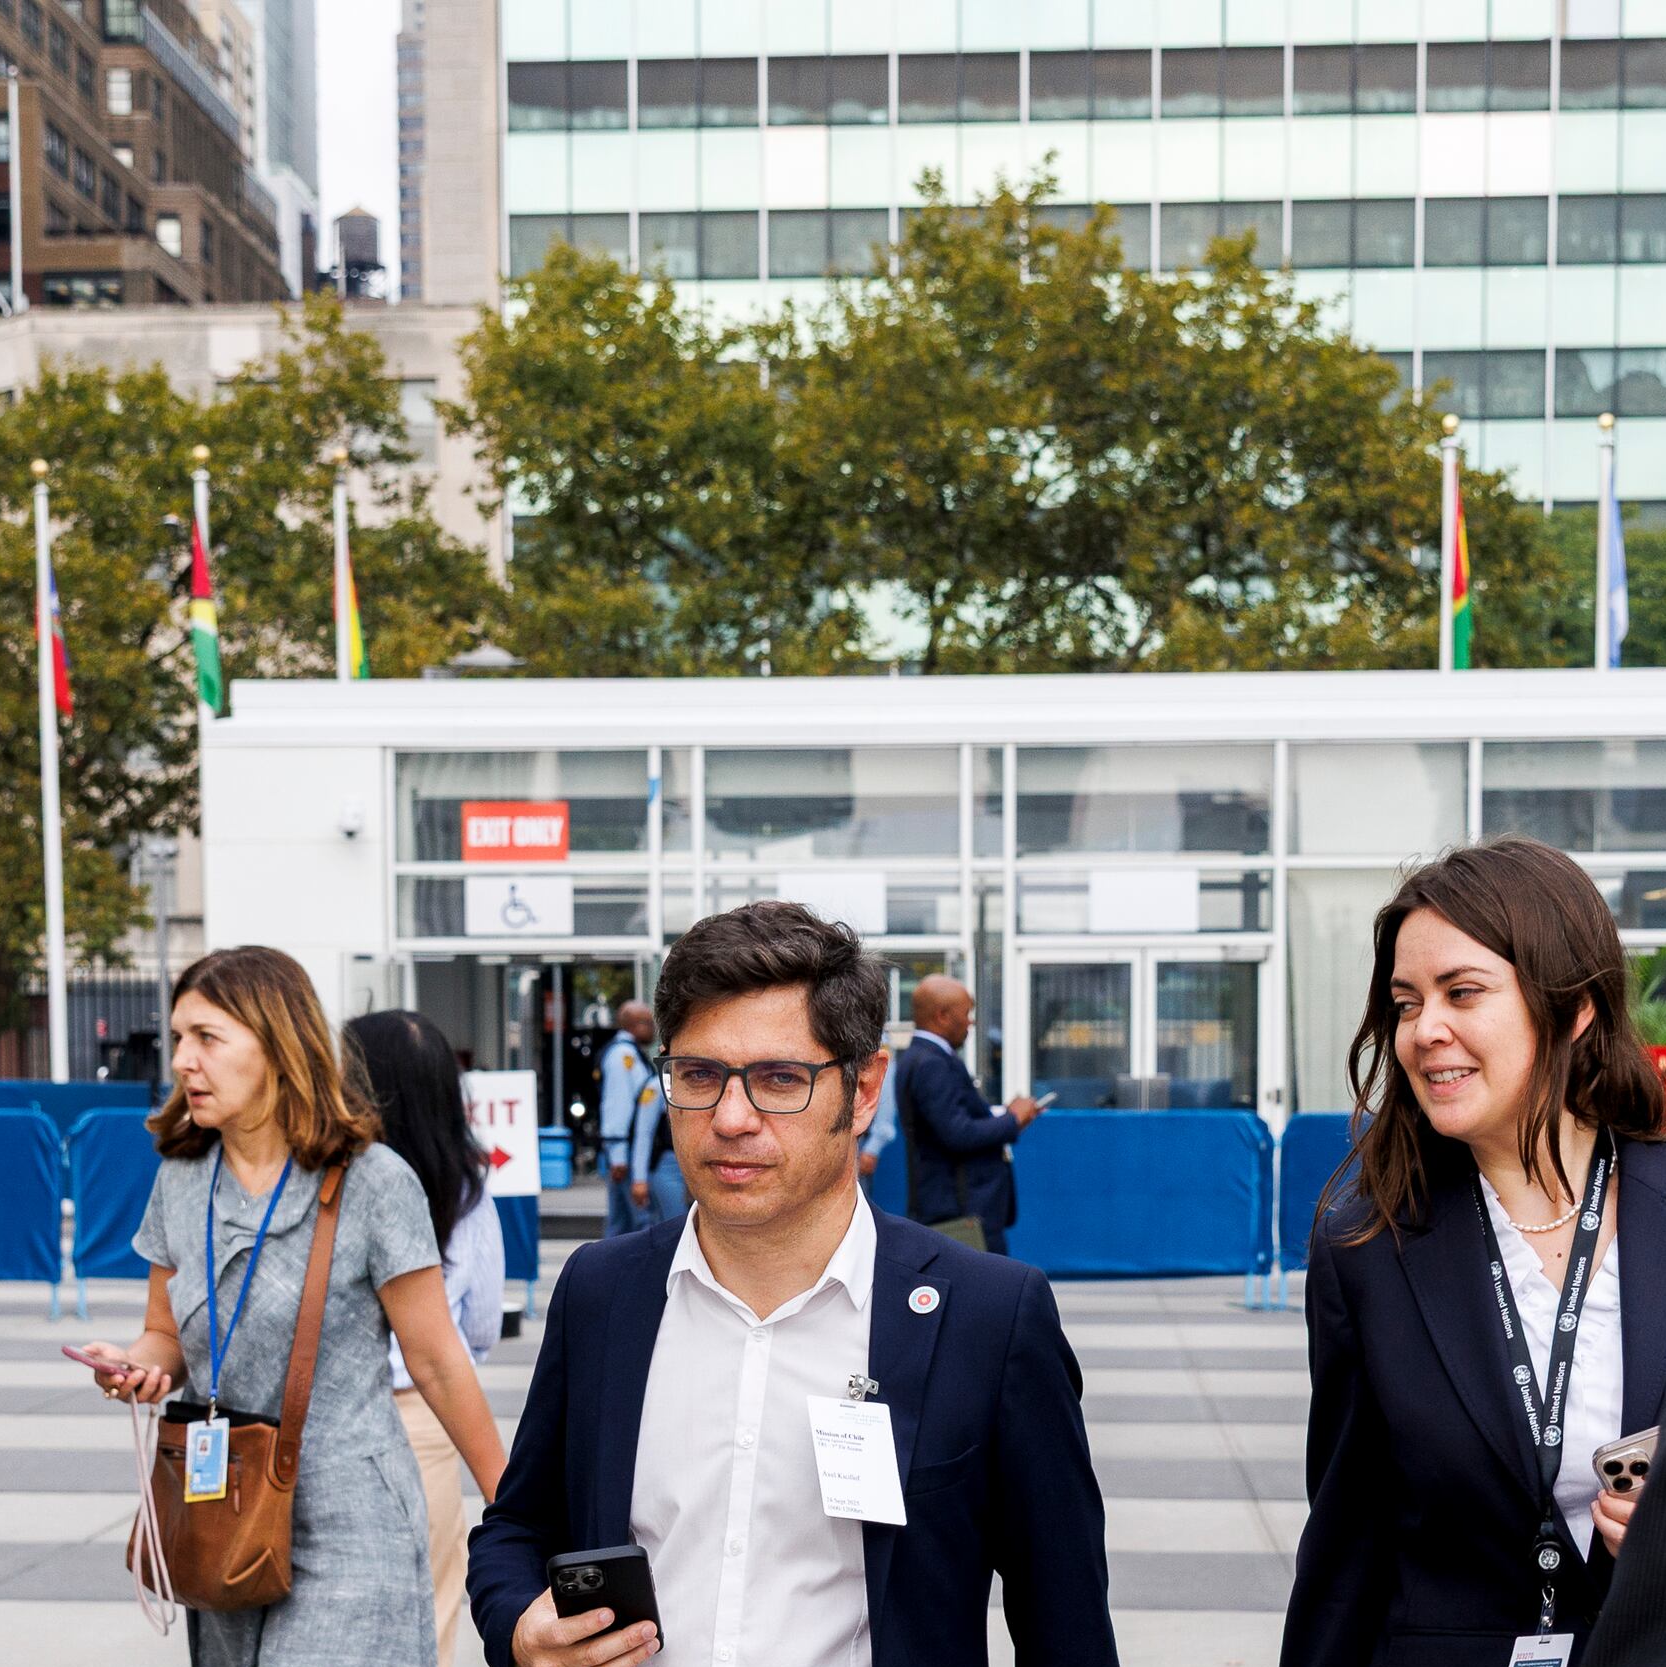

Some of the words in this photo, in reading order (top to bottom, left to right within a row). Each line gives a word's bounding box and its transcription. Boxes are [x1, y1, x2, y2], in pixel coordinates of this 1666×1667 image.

[467, 815, 510, 847] EXIT
[513, 815, 564, 847] ONLY
[465, 1099, 520, 1125] XIT
[1594, 1158, 1606, 1185] Nations
[1589, 1186, 1600, 1211] United
[1572, 1256, 1586, 1287] Nations
[1494, 1281, 1507, 1308] United
[1566, 1287, 1579, 1312] United
[1500, 1307, 1514, 1340] Nations
[1553, 1360, 1566, 1394] Nations
[1520, 1385, 1535, 1412] United
[1550, 1394, 1561, 1424] United
[848, 1433, 865, 1441] Chile
[1527, 1412, 1541, 1446] Nations
